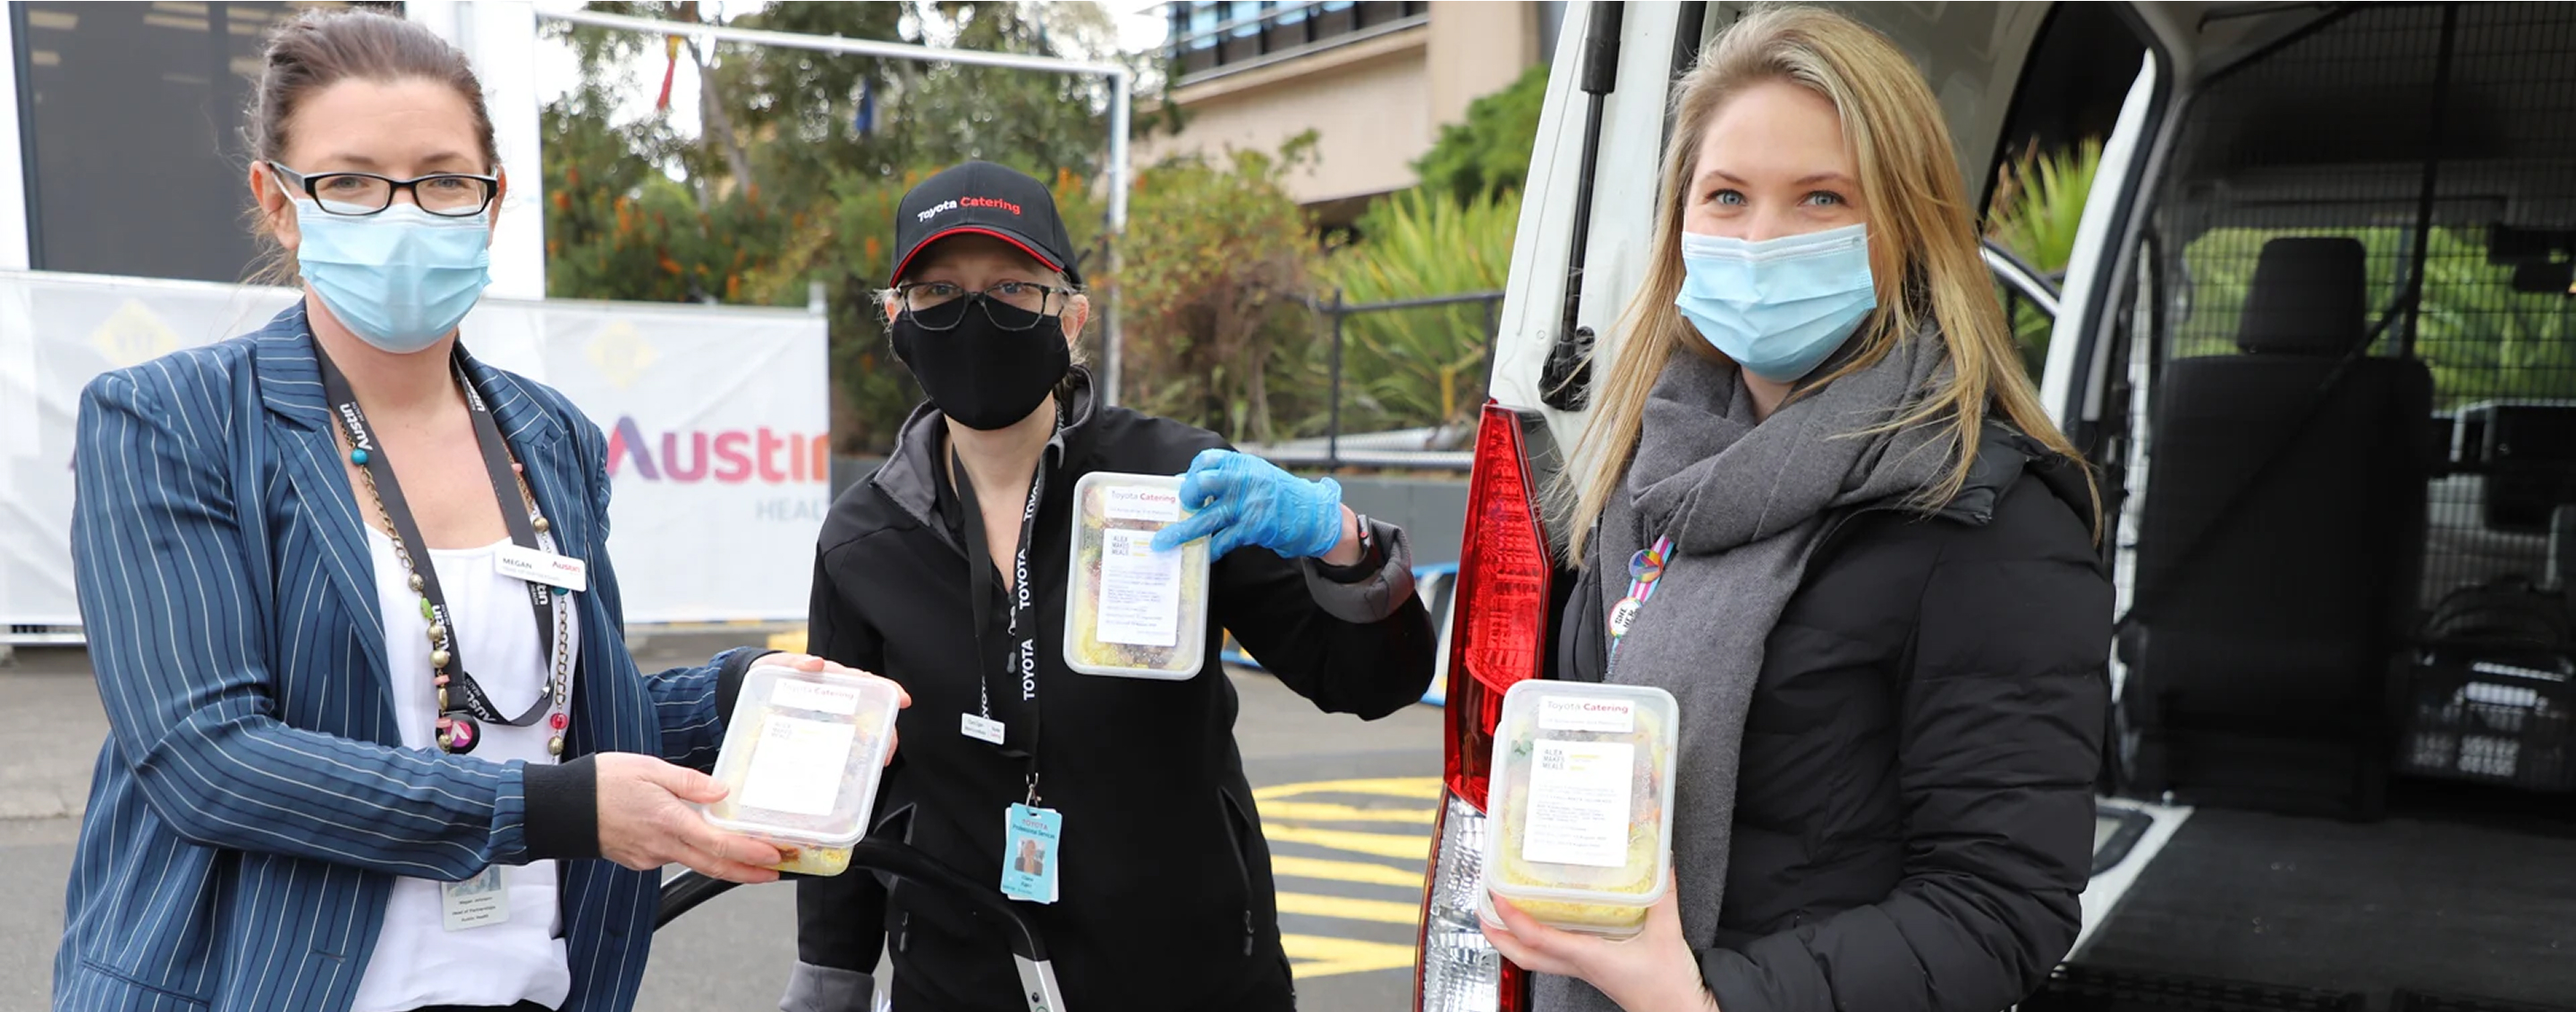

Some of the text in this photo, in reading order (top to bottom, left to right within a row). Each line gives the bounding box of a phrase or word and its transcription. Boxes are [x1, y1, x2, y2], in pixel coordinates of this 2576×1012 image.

[917, 196, 1021, 222] Toyota Catering
[339, 403, 373, 450] Austin
[1112, 490, 1175, 504] Toyota Catering
[503, 557, 532, 569] MEGAN
[552, 561, 580, 574] Austin
[1017, 549, 1031, 610] TOYOTA
[1021, 639, 1036, 701] TOYOTA
[1547, 701, 1629, 714] Toyota Catering
[1022, 819, 1048, 830] TOYOTA
